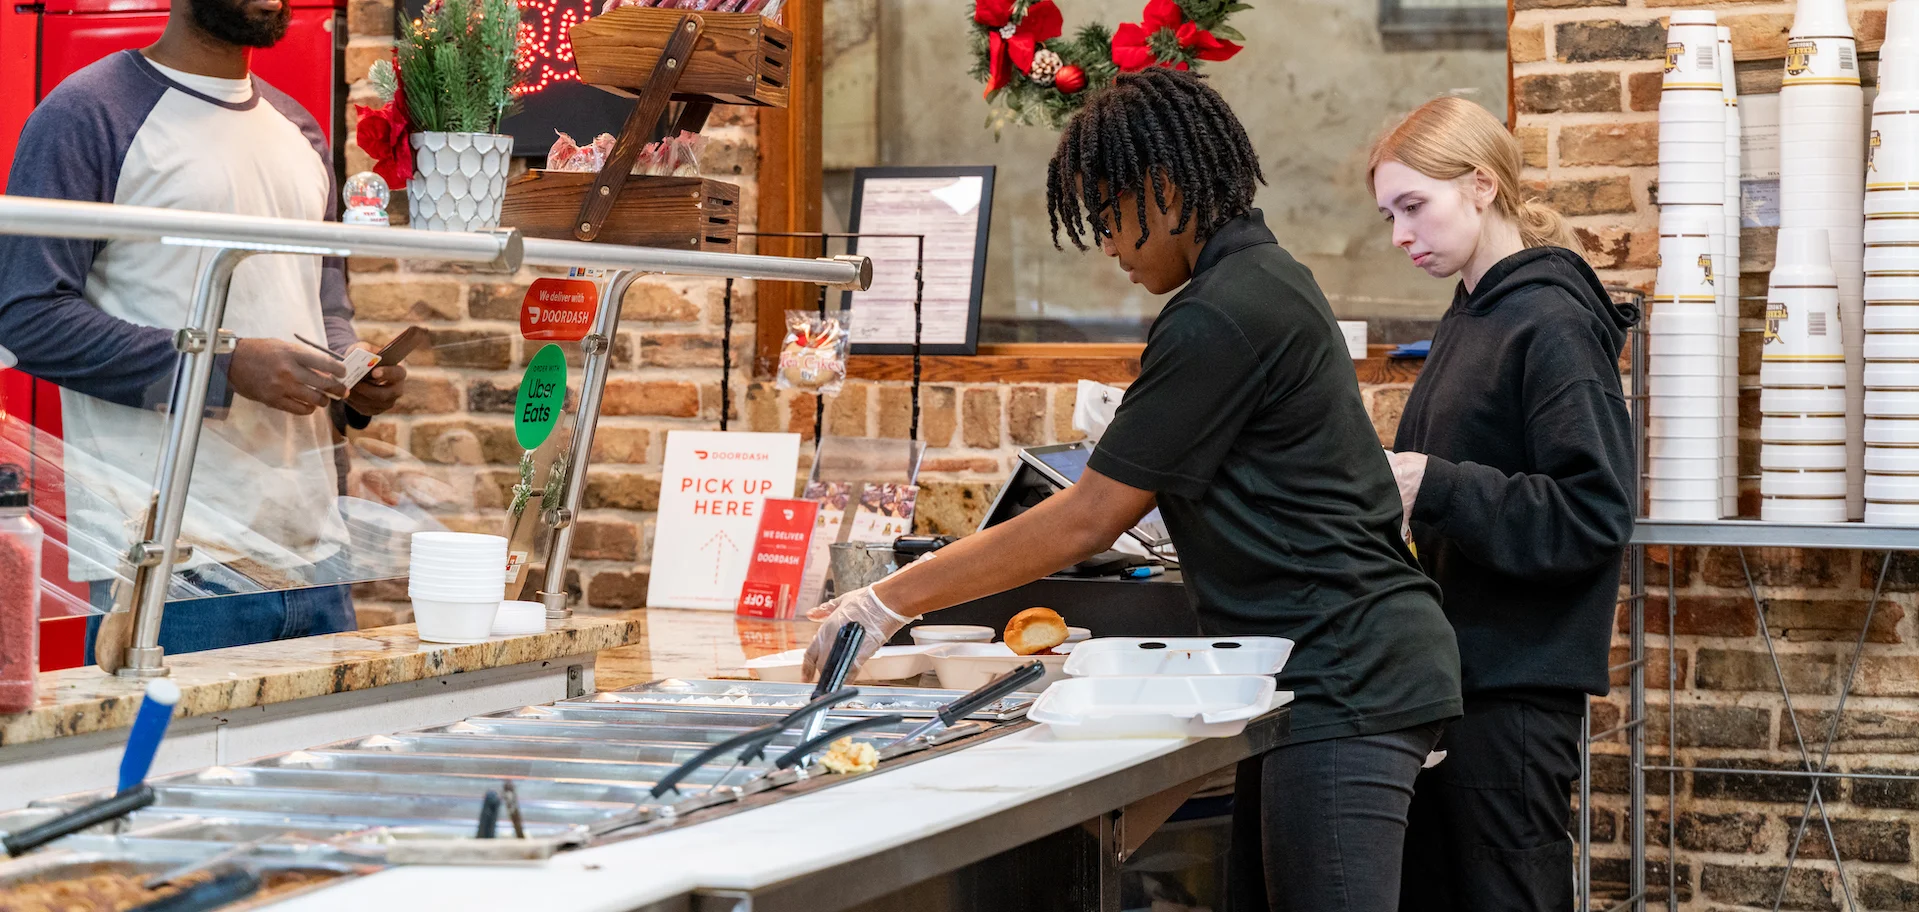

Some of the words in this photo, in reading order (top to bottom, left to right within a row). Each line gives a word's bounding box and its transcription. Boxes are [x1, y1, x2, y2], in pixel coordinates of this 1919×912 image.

[540, 290, 549, 301] We
[550, 291, 571, 302] deliver
[572, 292, 584, 303] with
[542, 309, 589, 323] DOORDASH
[804, 355, 841, 371] Ckes
[528, 378, 556, 399] Uber
[522, 402, 550, 423] Eats
[712, 452, 769, 461] DOORDASH
[680, 477, 735, 494] PICK
[743, 479, 773, 495] UP
[694, 500, 754, 517] HERE
[763, 530, 774, 539] WE
[775, 531, 804, 541] DELIVER
[757, 552, 800, 565] DOORDASH
[743, 593, 764, 606] OFF
